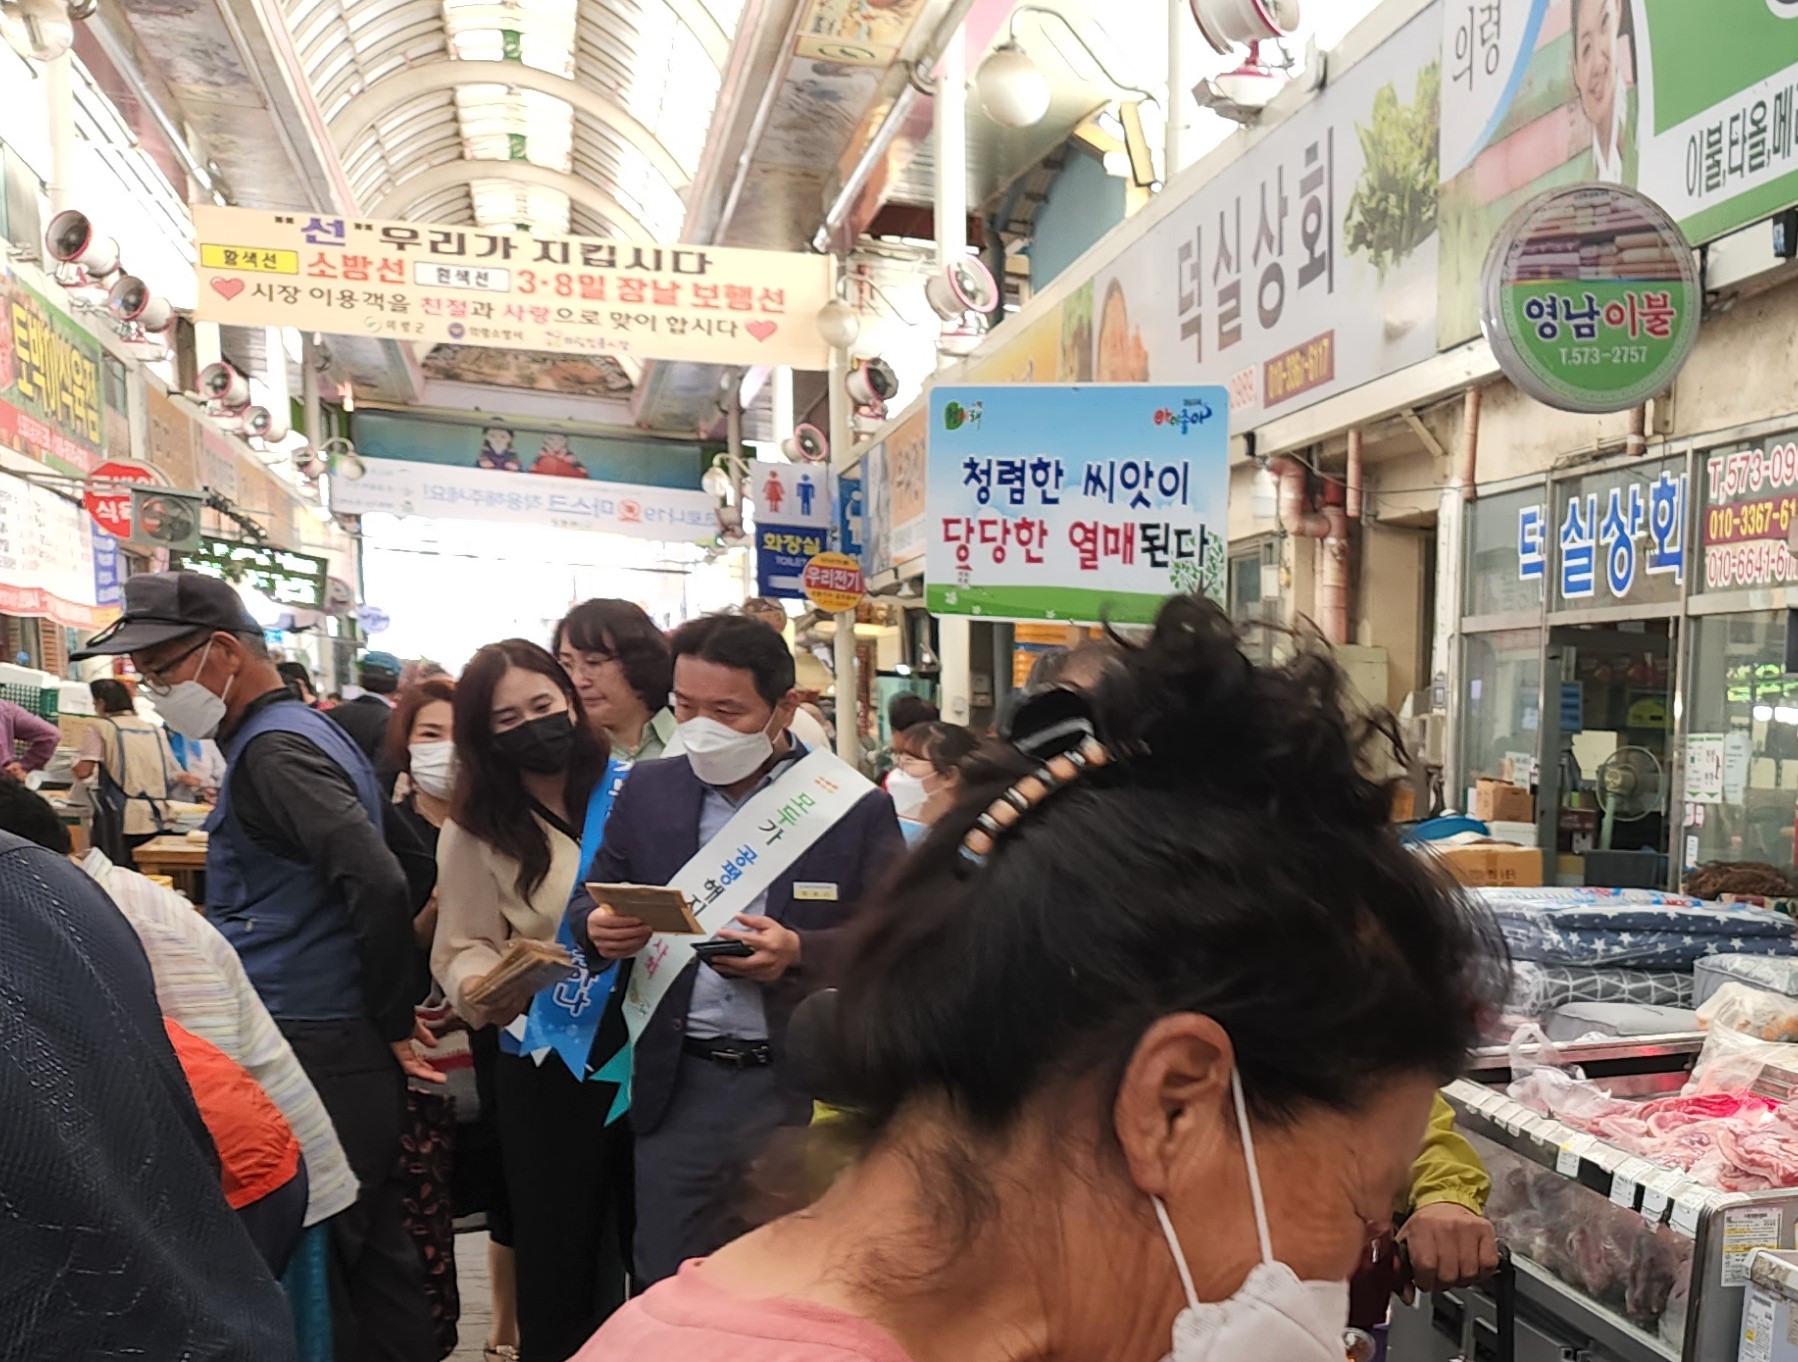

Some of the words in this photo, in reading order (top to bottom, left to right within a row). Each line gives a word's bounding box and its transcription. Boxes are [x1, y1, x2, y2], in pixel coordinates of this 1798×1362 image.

[1452, 2, 1502, 92] 의령
[532, 238, 714, 275] 지킵시다
[1177, 126, 1335, 364] 덕실상회
[307, 252, 407, 285] 소방선
[617, 275, 682, 308] 장날
[690, 281, 785, 315] 보행선
[251, 283, 301, 305] 시장
[309, 286, 411, 315] 이용객을
[420, 295, 495, 321] 친절과
[503, 303, 601, 326] 사랑으로
[609, 311, 657, 333] 맞이
[665, 315, 738, 340] 합시다
[1524, 290, 1676, 341] 영남이불
[1558, 345, 1648, 366] T.573-2757
[962, 456, 1064, 506] 청렴한
[1082, 459, 1190, 510] 씨앗이
[762, 532, 821, 556] 화장실
[942, 516, 1049, 565] 당당한
[1067, 520, 1211, 571] 열매된다
[806, 566, 860, 593] 우리전기
[757, 791, 816, 846] 모두가
[687, 843, 758, 916] 공평해지
